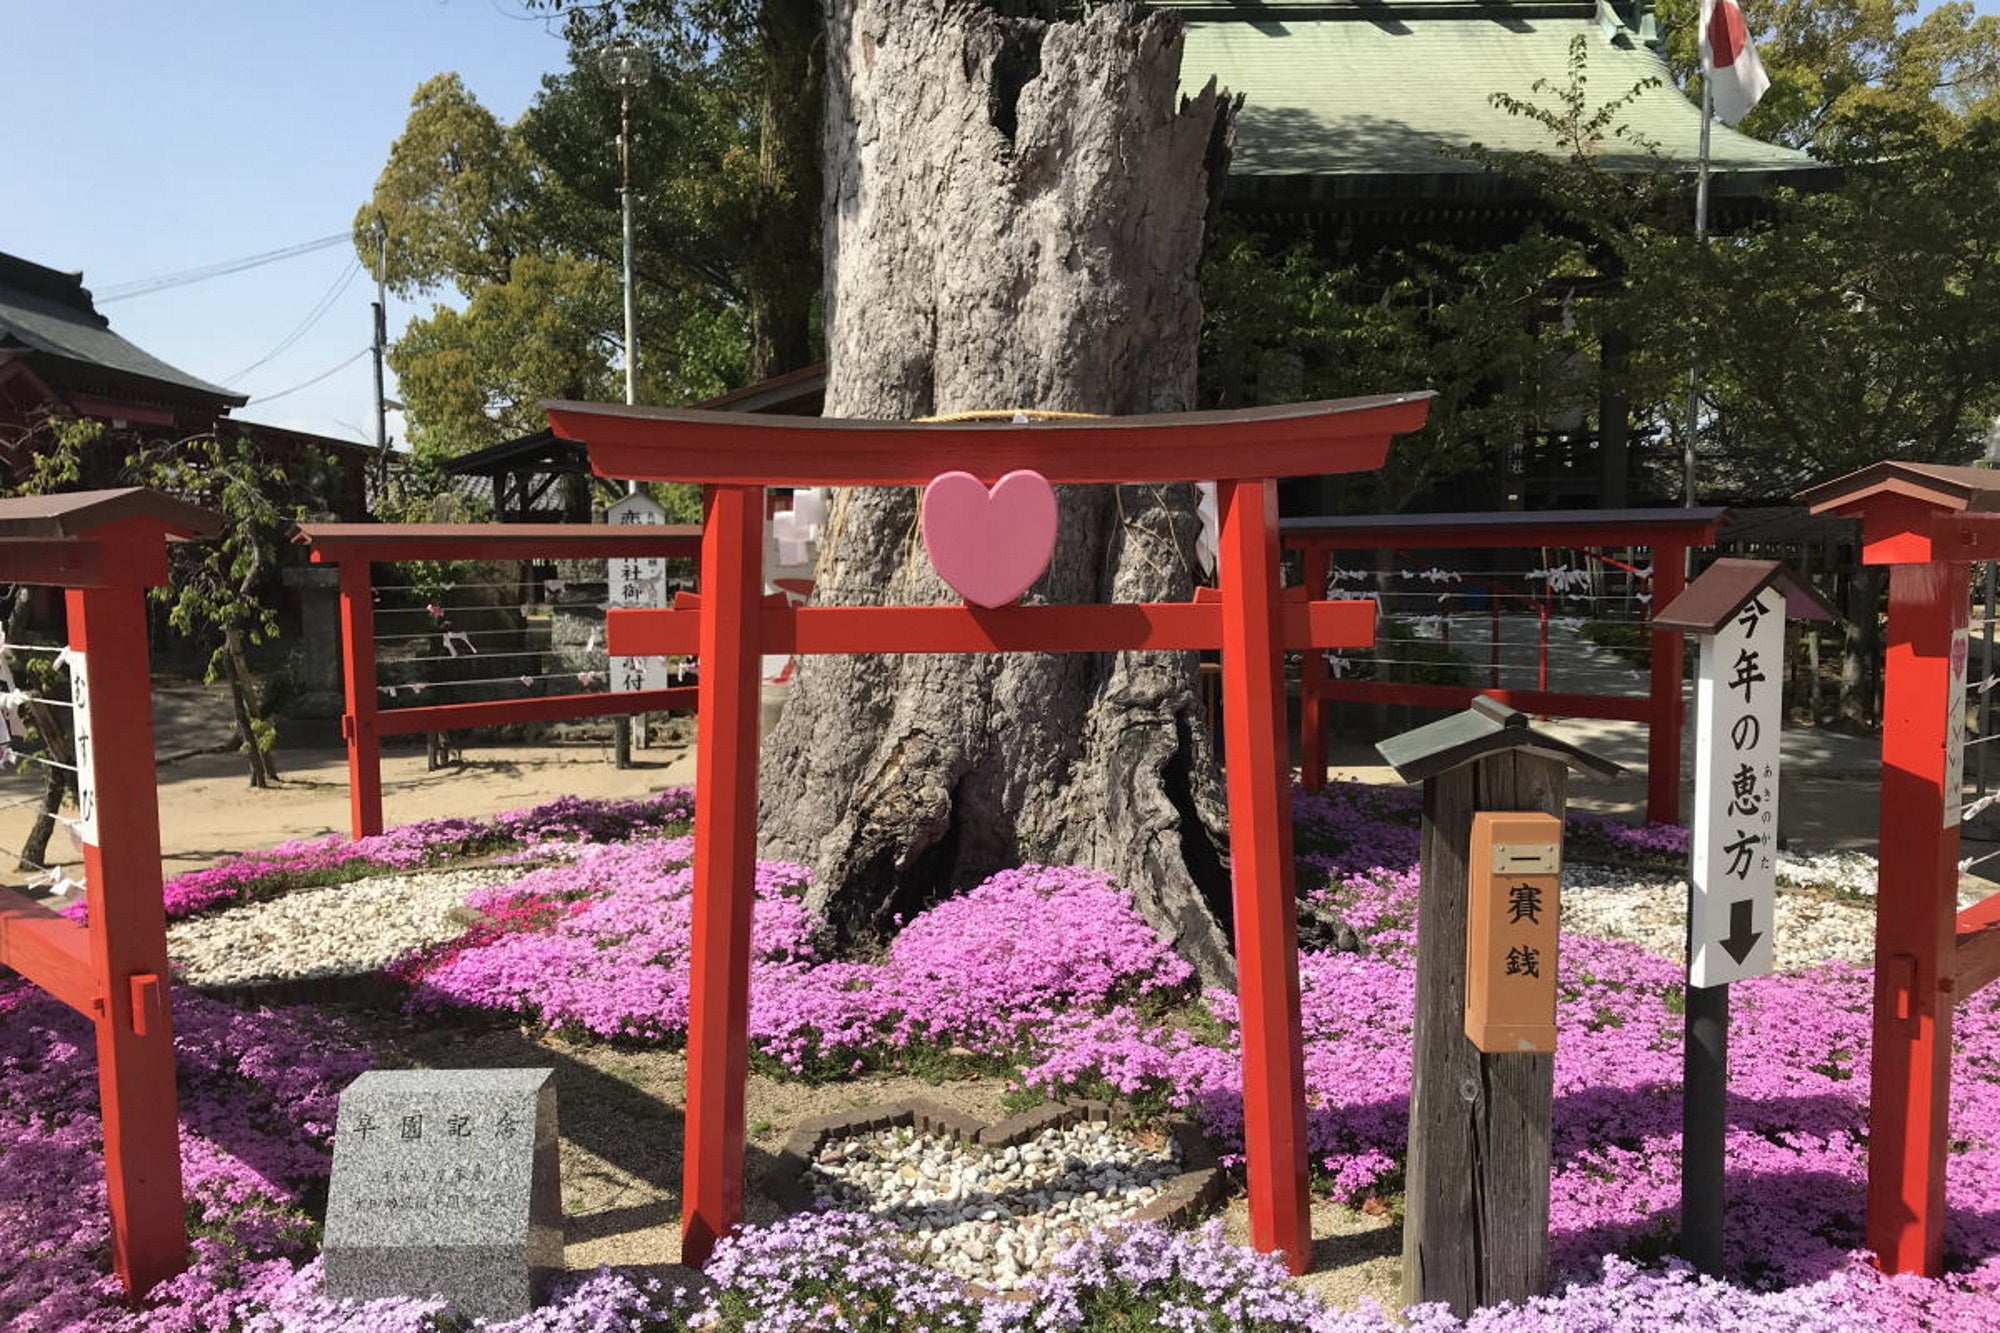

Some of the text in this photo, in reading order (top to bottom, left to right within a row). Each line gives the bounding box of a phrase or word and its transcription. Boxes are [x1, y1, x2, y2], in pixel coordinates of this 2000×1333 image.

[1723, 597, 1770, 880] 今年の恵方
[1506, 883, 1543, 978] 賽銭
